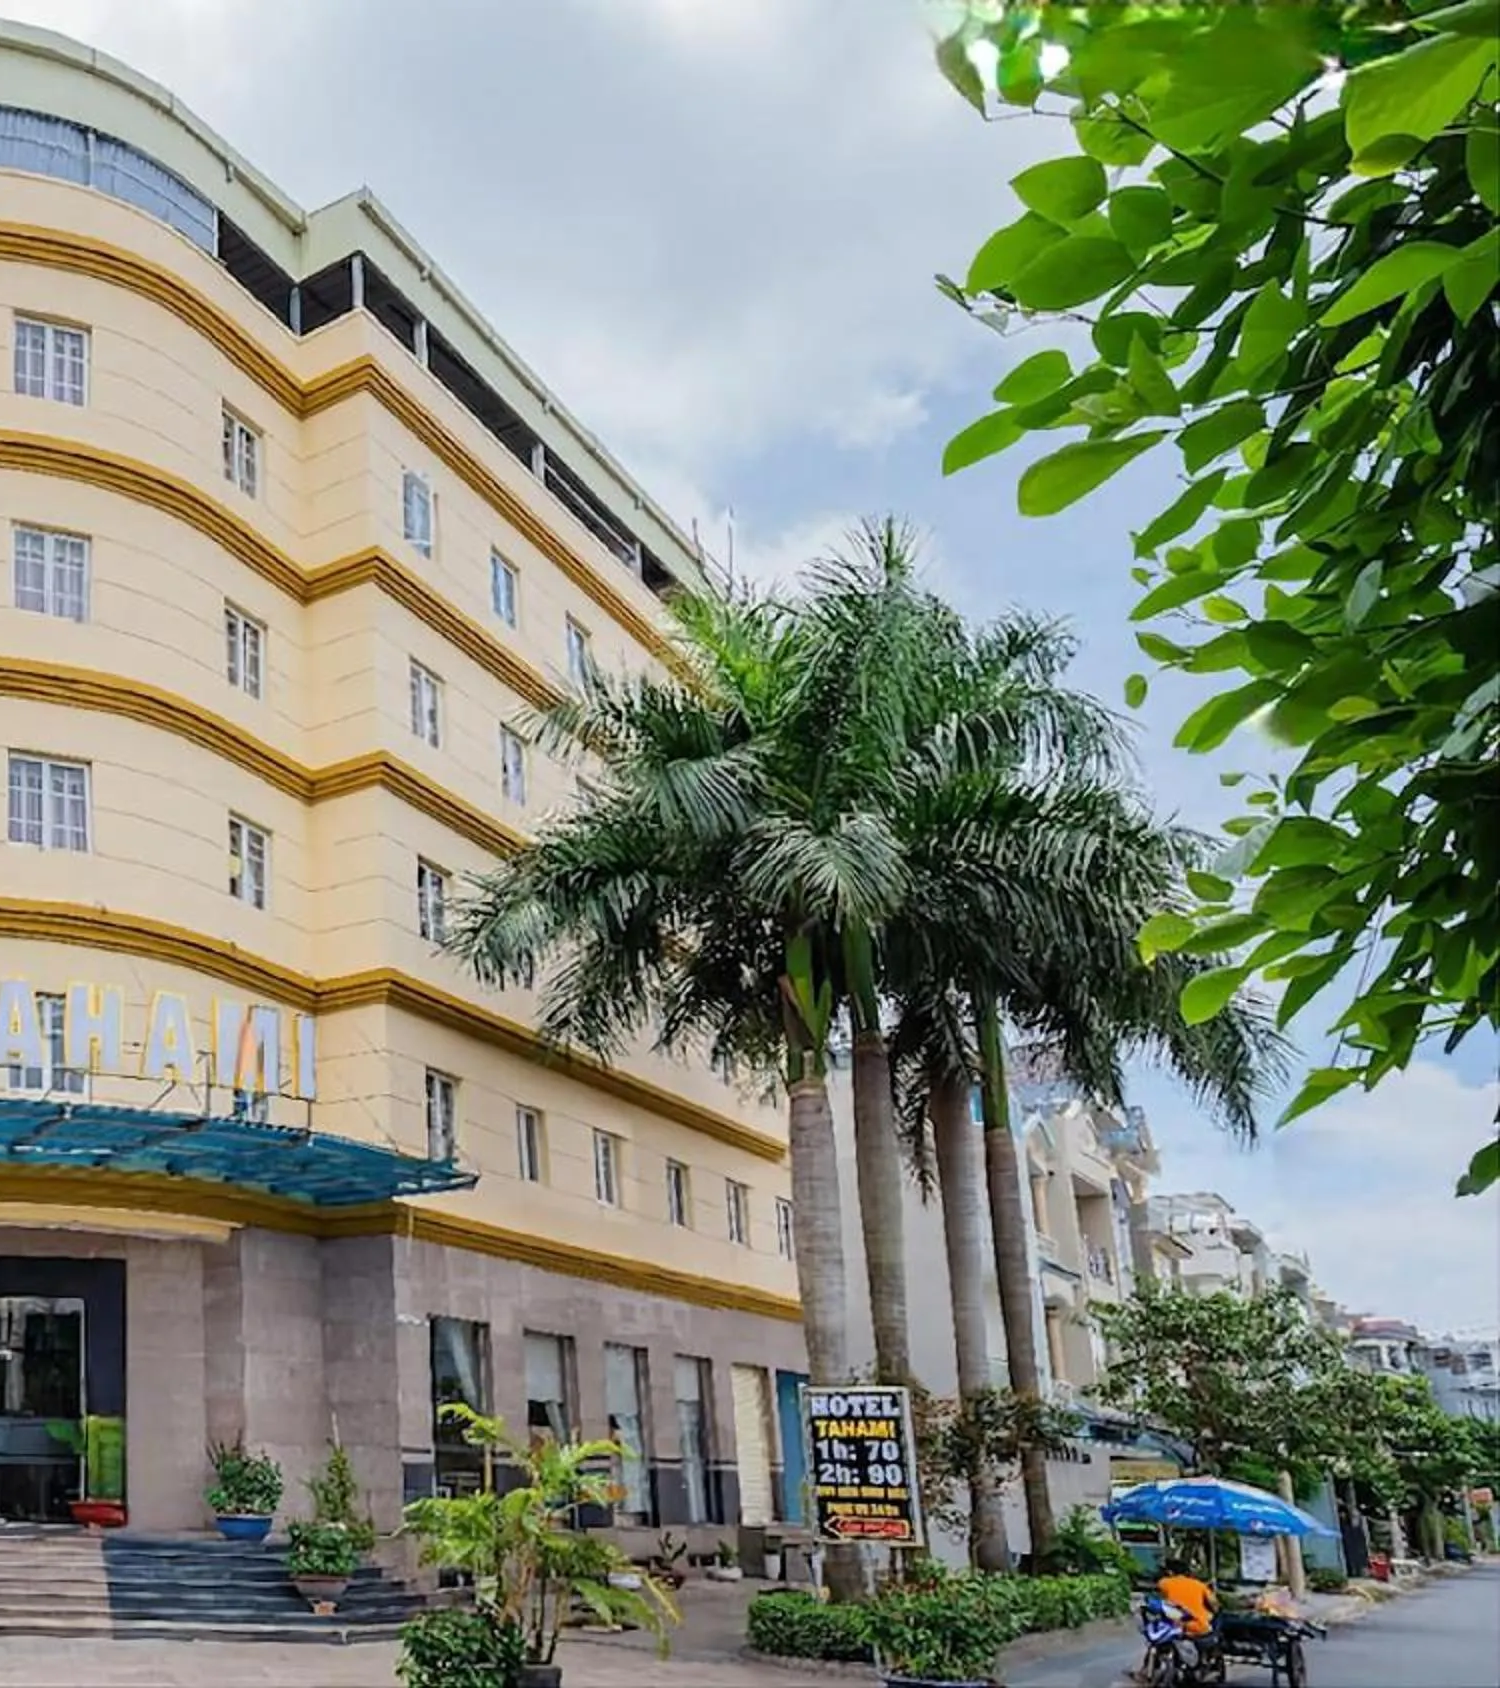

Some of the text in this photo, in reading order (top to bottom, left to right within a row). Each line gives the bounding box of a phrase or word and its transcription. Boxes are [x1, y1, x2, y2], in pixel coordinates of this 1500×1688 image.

[811, 1395, 900, 1417] HOTEL
[815, 1420, 896, 1438] TAHAMI
[816, 1440, 899, 1461] 1h: 70
[819, 1463, 902, 1487] 2h: 90
